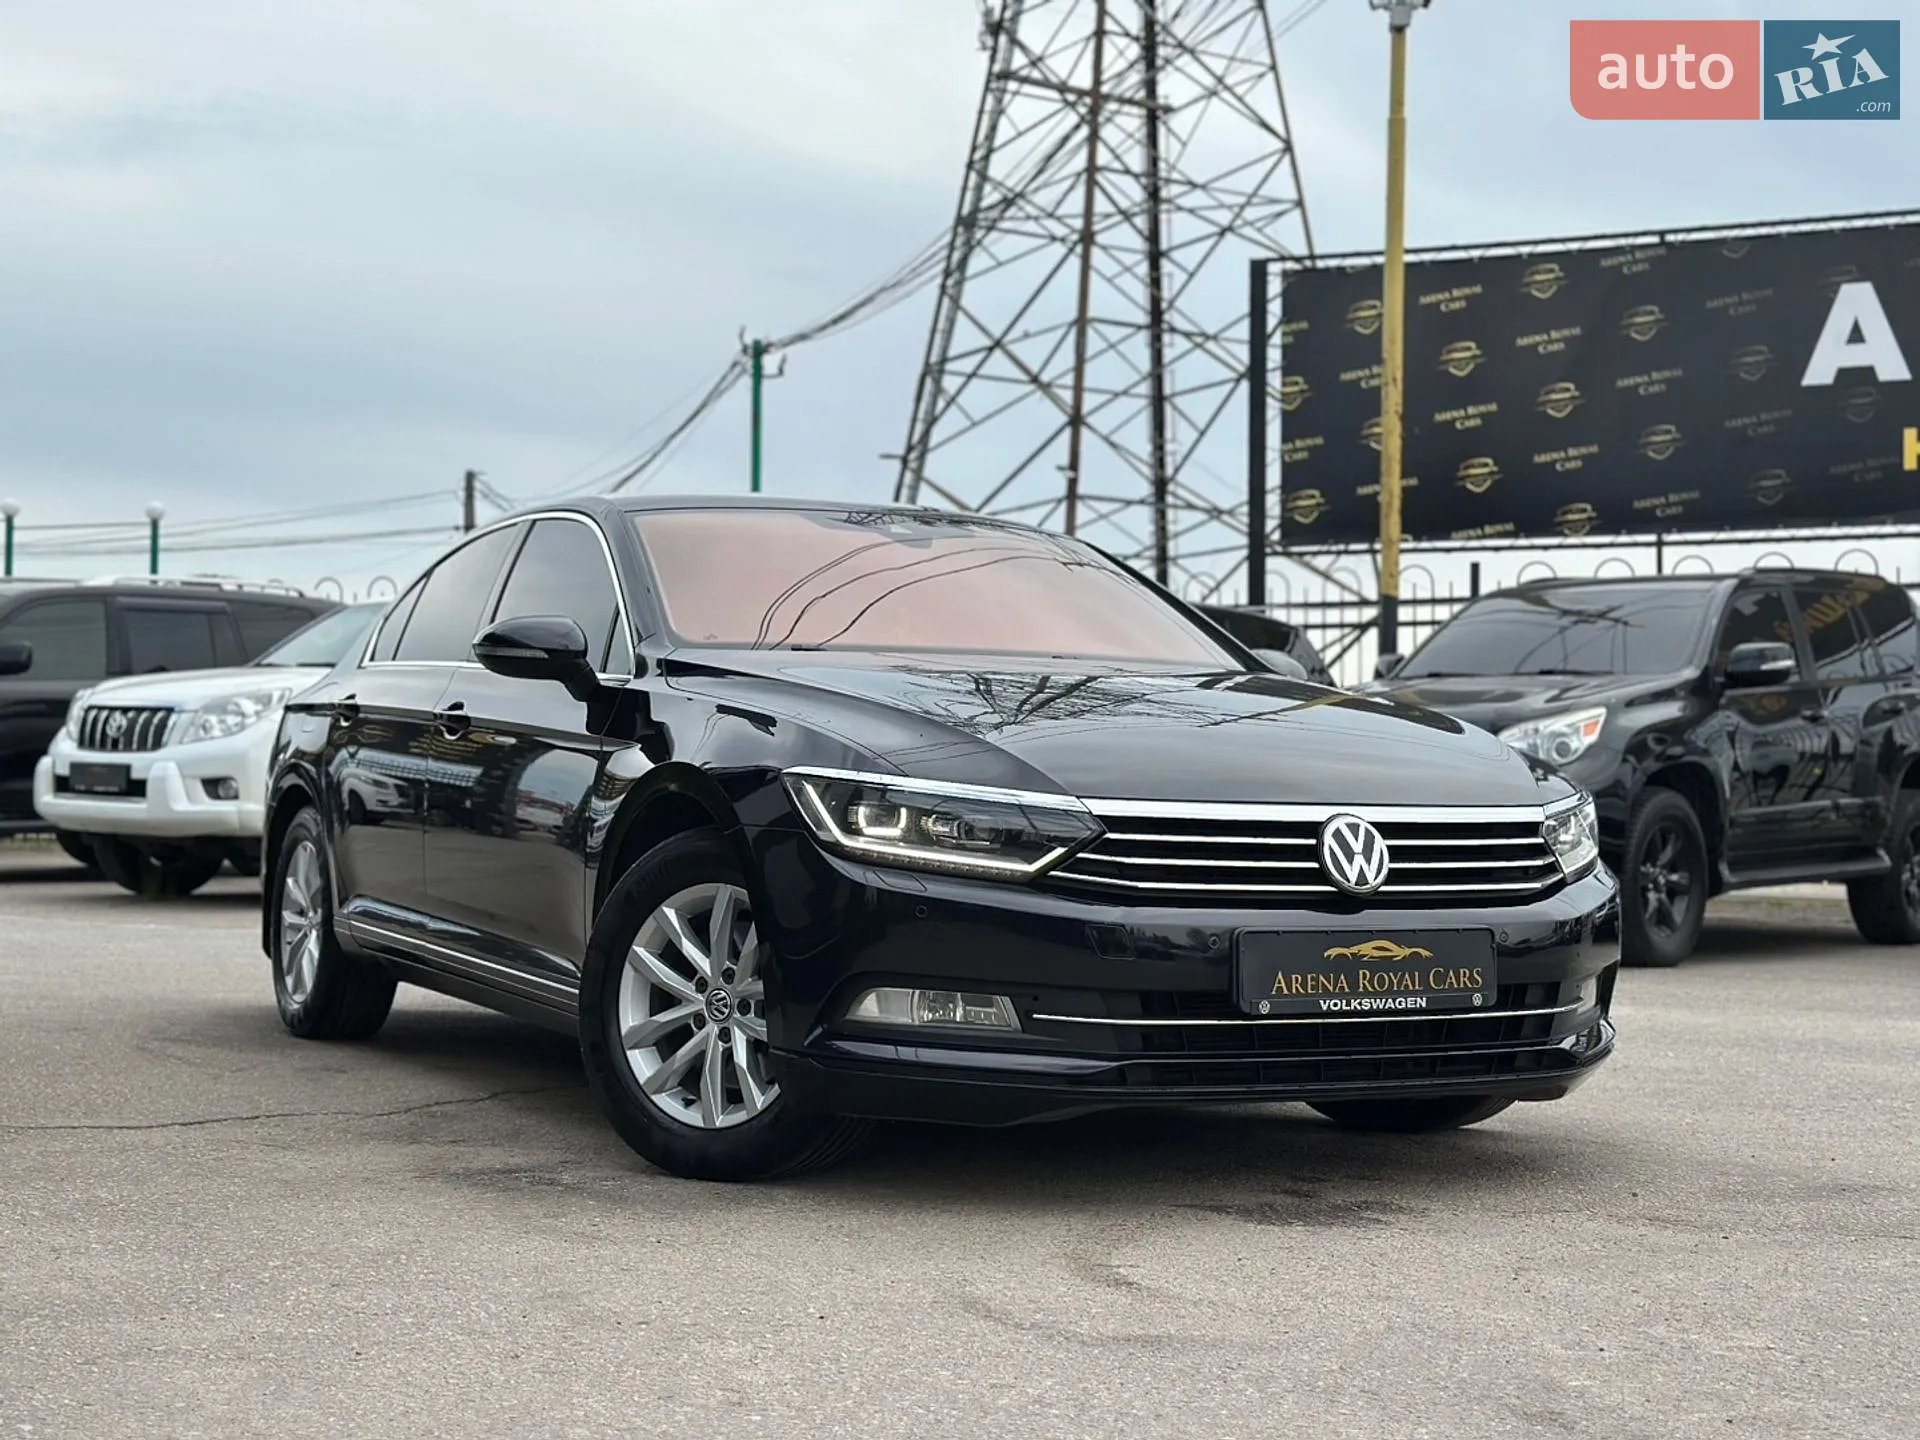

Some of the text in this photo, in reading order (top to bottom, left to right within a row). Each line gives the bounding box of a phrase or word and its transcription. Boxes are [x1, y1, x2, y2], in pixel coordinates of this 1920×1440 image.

[1271, 967, 1483, 995] ARENA ROYAL CARS
[1319, 997, 1427, 1011] VOLKSWAGEN
